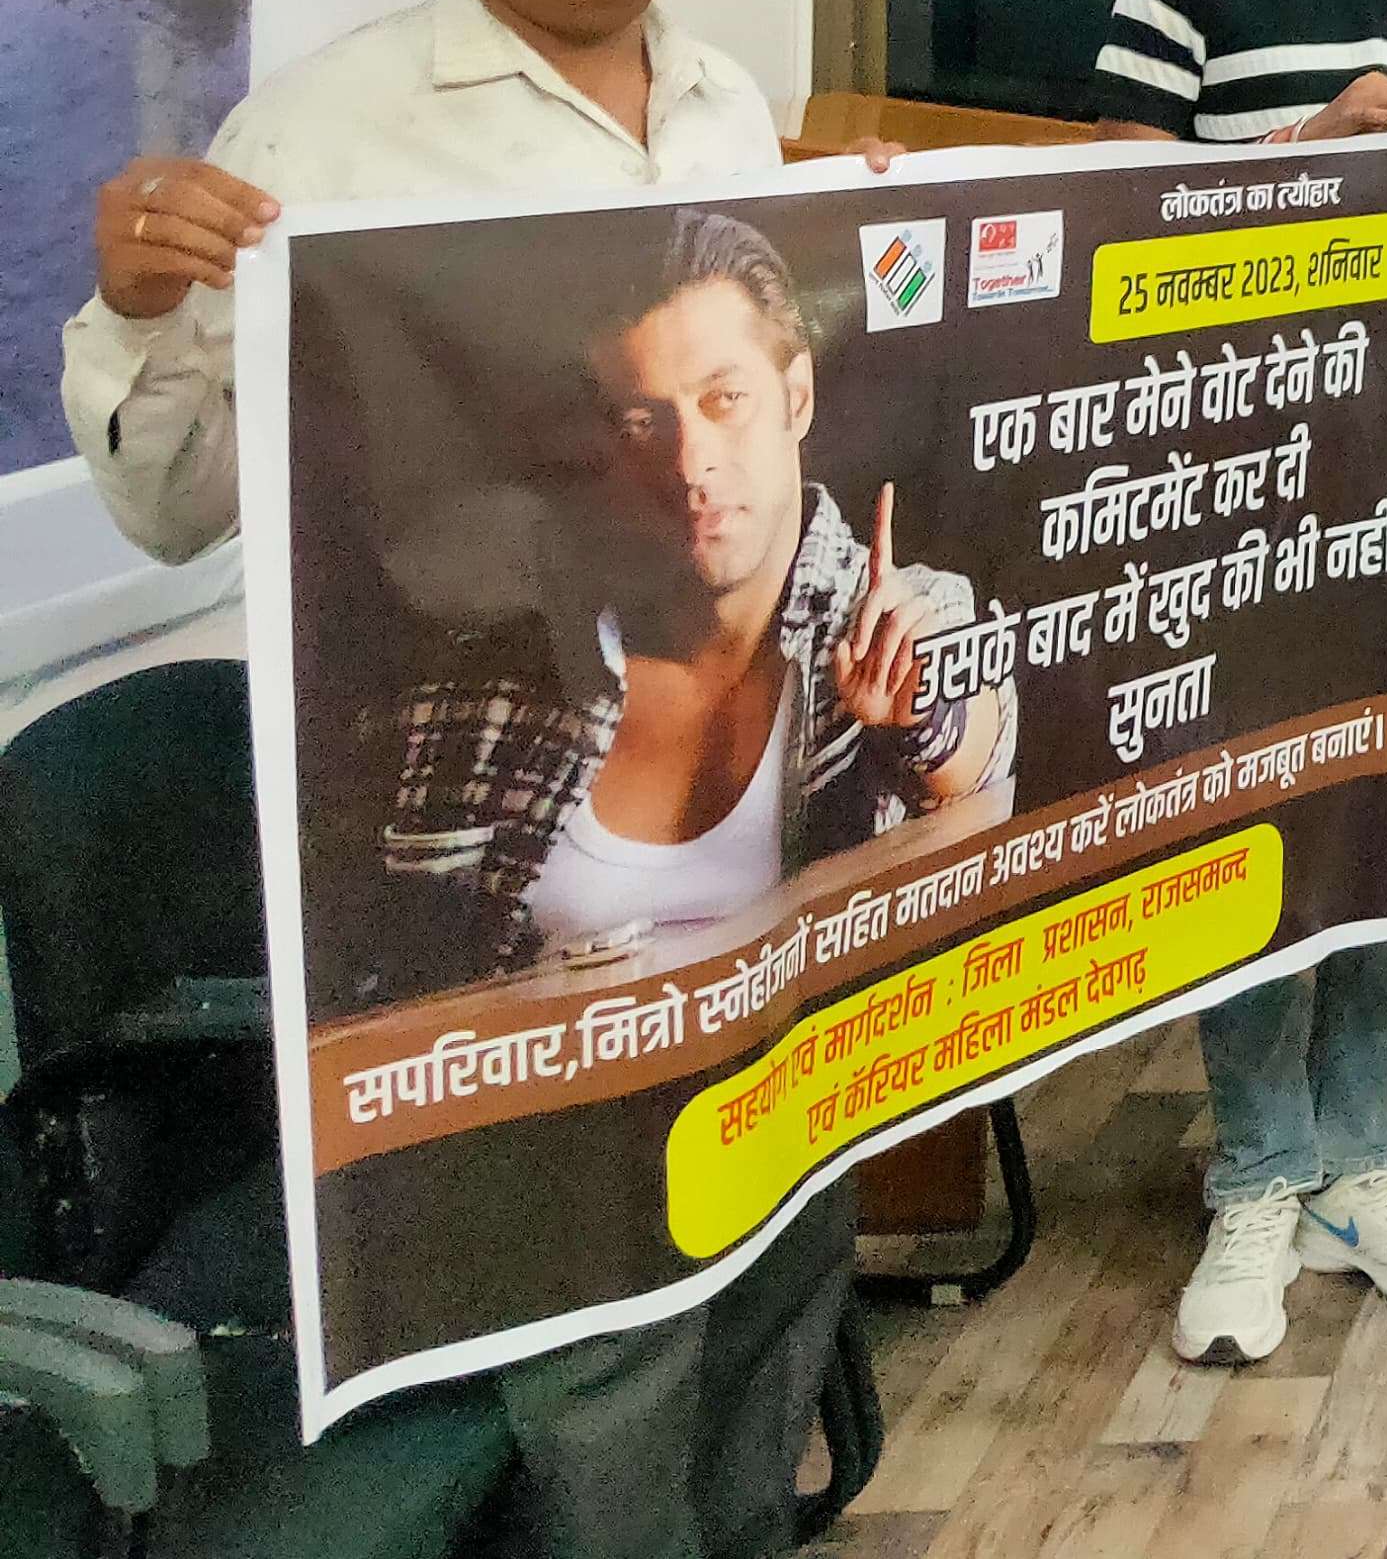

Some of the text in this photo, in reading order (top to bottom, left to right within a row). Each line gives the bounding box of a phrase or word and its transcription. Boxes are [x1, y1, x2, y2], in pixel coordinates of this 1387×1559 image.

[1160, 171, 1343, 221] लोकतंत्र का त्यौहार
[1119, 238, 1384, 315] 25 नवम्बर 2023, शनिवार
[969, 321, 1370, 471] एक बार मेने वोट देने की
[1040, 422, 1312, 561] कमिटमेंट कर दी
[915, 598, 1018, 712] उसके
[1026, 591, 1100, 668] बाद
[1103, 560, 1148, 643] में
[1148, 558, 1218, 649] खुद
[1221, 528, 1270, 610] की
[1274, 514, 1321, 592] भी
[1108, 653, 1217, 763] सुनता
[694, 912, 814, 1033] स्नेहीजनों
[815, 890, 892, 963] सहित
[895, 852, 987, 925] मतदान
[990, 820, 1067, 885] अवश्य
[1070, 793, 1112, 853] करें
[1114, 771, 1200, 837] लोकतंत्र
[1202, 750, 1234, 803] को
[1236, 733, 1309, 790] मजबूत
[717, 1054, 789, 1146] सहयोग
[790, 1025, 818, 1090] एवं
[824, 974, 936, 1065] मार्गदर्शन
[962, 937, 1025, 998] जिला
[1141, 846, 1250, 921] राजसमन्द
[807, 1078, 838, 1145] एवं
[933, 1008, 1015, 1073] महिला
[1019, 974, 1082, 1034] मंडल
[1085, 945, 1149, 1006] देवगढ़
